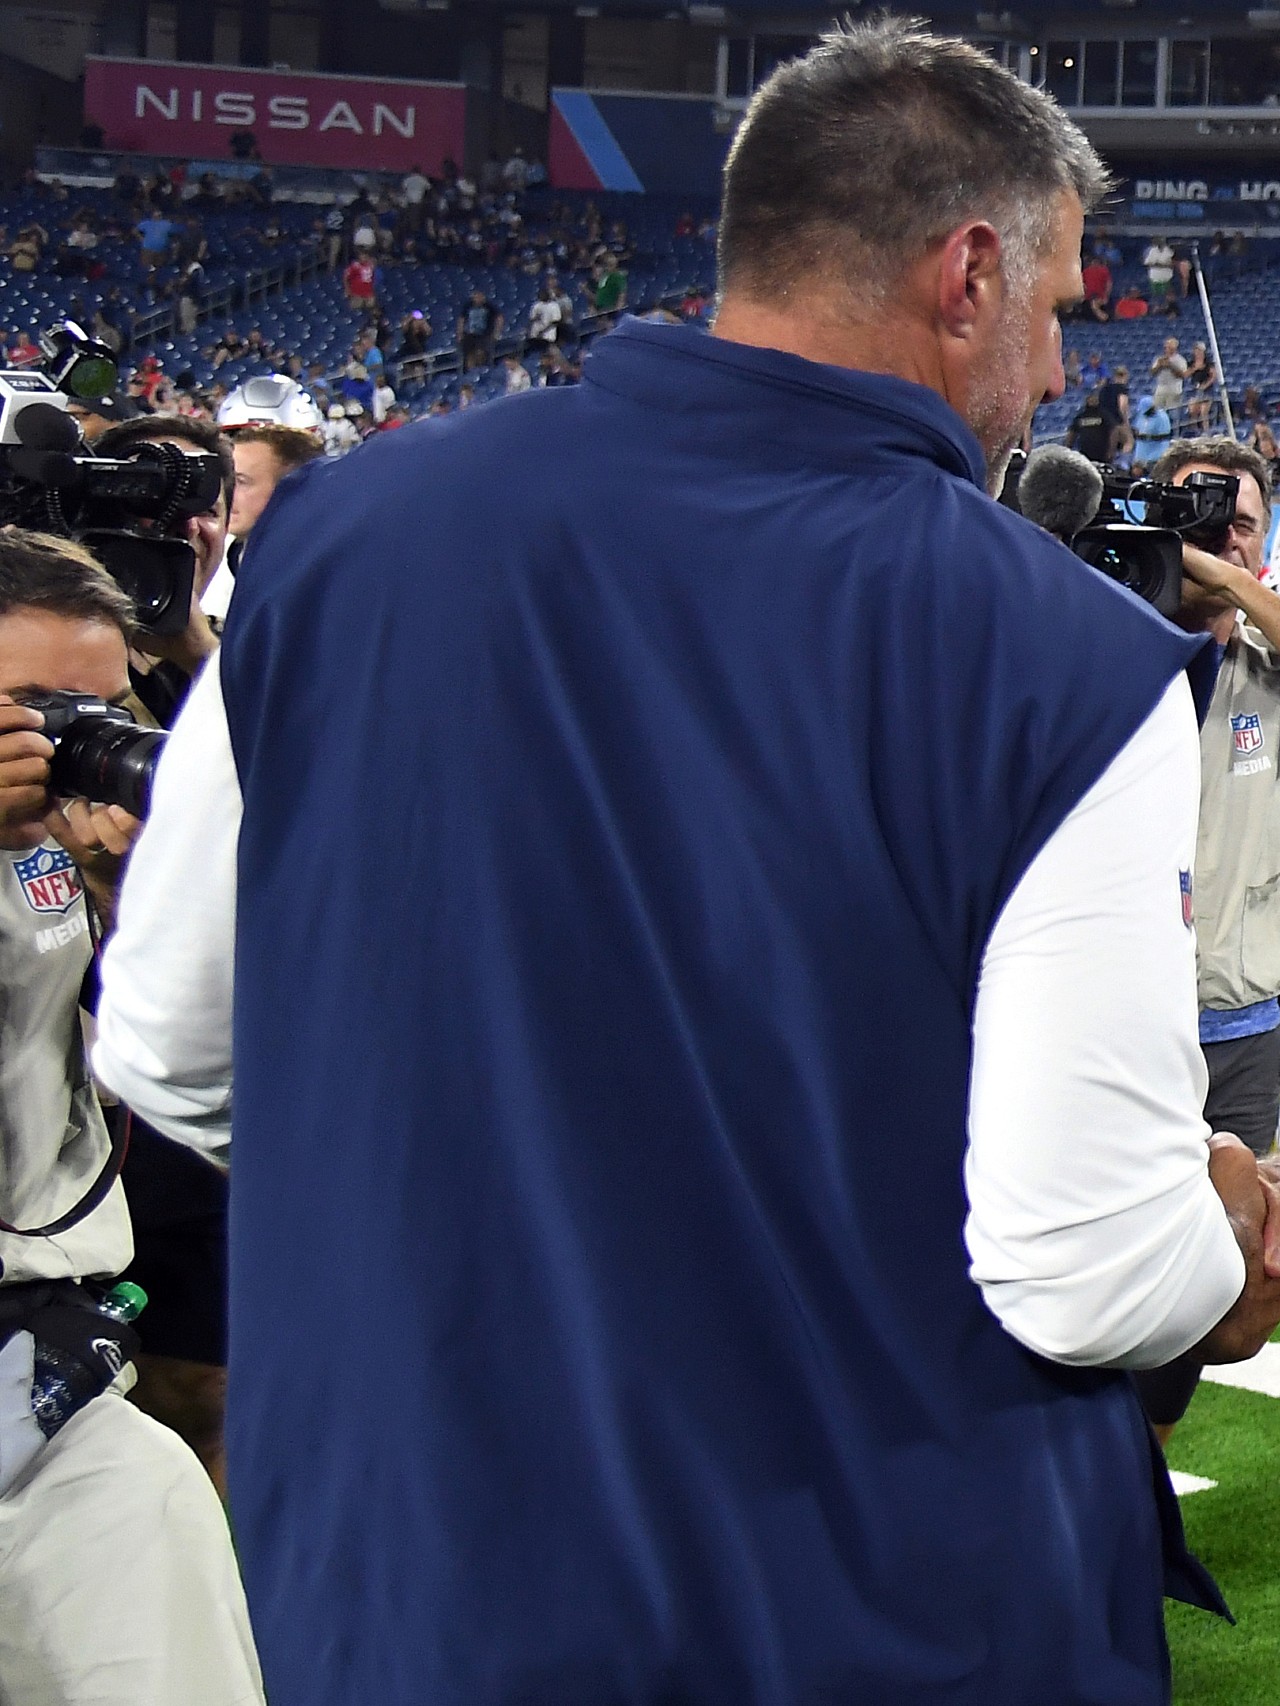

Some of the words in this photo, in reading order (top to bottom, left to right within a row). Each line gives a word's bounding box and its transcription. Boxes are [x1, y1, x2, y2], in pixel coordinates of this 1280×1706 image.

[135, 85, 415, 138] NISSAN
[1235, 730, 1260, 749] NFL
[1233, 756, 1271, 776] MEDIA
[28, 871, 81, 906] NFL
[36, 911, 89, 953] MEDI
